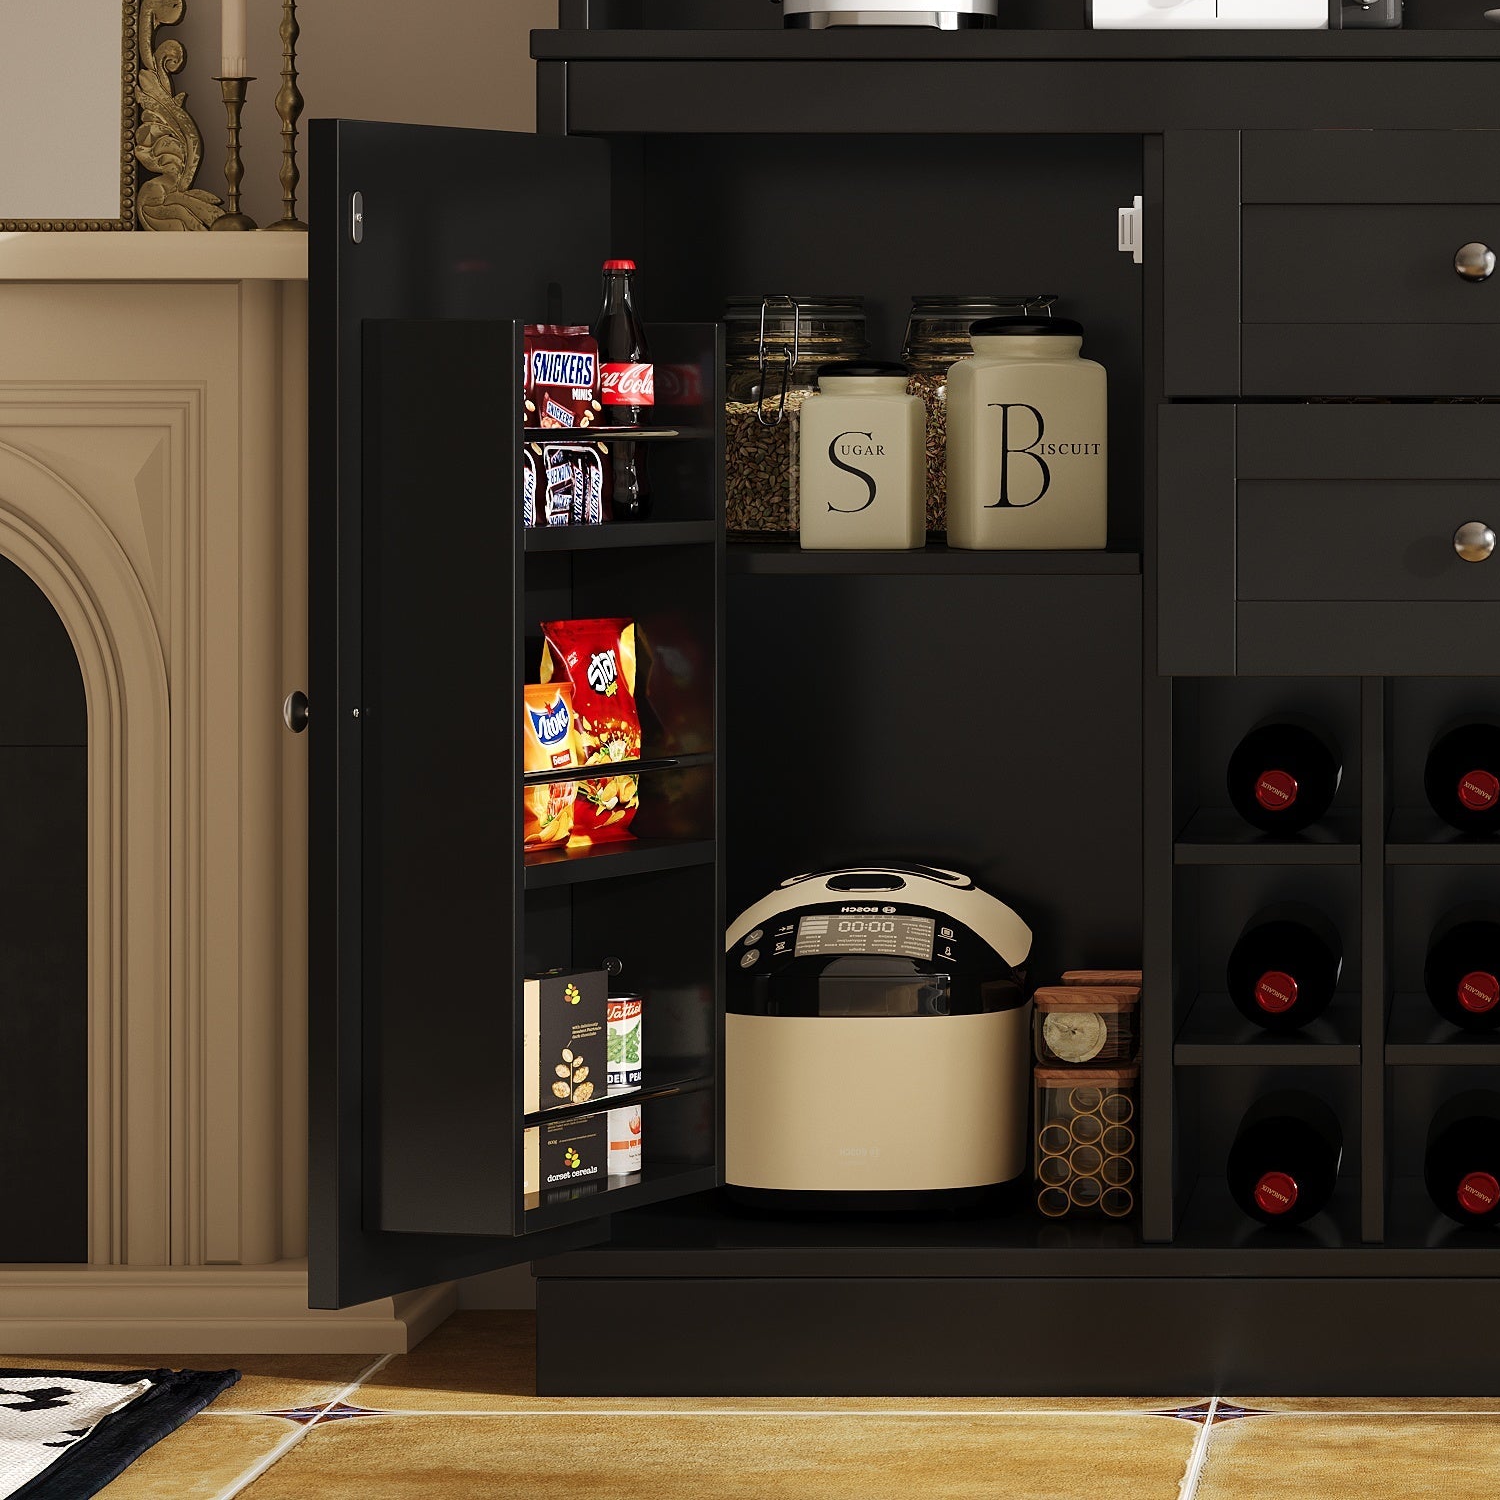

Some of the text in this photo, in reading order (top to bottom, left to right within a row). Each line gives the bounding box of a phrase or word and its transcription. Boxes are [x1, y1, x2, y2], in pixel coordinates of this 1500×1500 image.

[534, 352, 594, 387] SNICKERS
[572, 388, 593, 401] MINIS
[546, 402, 574, 427] SNICKERS
[983, 403, 1101, 509] BISCUIT
[828, 431, 886, 513] SUGAR
[1261, 780, 1290, 800] MARGAUX
[1463, 780, 1492, 800] MARGAUX
[1261, 982, 1290, 1003] MARGAUX
[1463, 982, 1492, 1003] MARGAUX
[547, 1165, 598, 1183] dorset cereals
[1261, 1183, 1290, 1204] MARGAUX
[1463, 1183, 1492, 1204] MARGAUX
